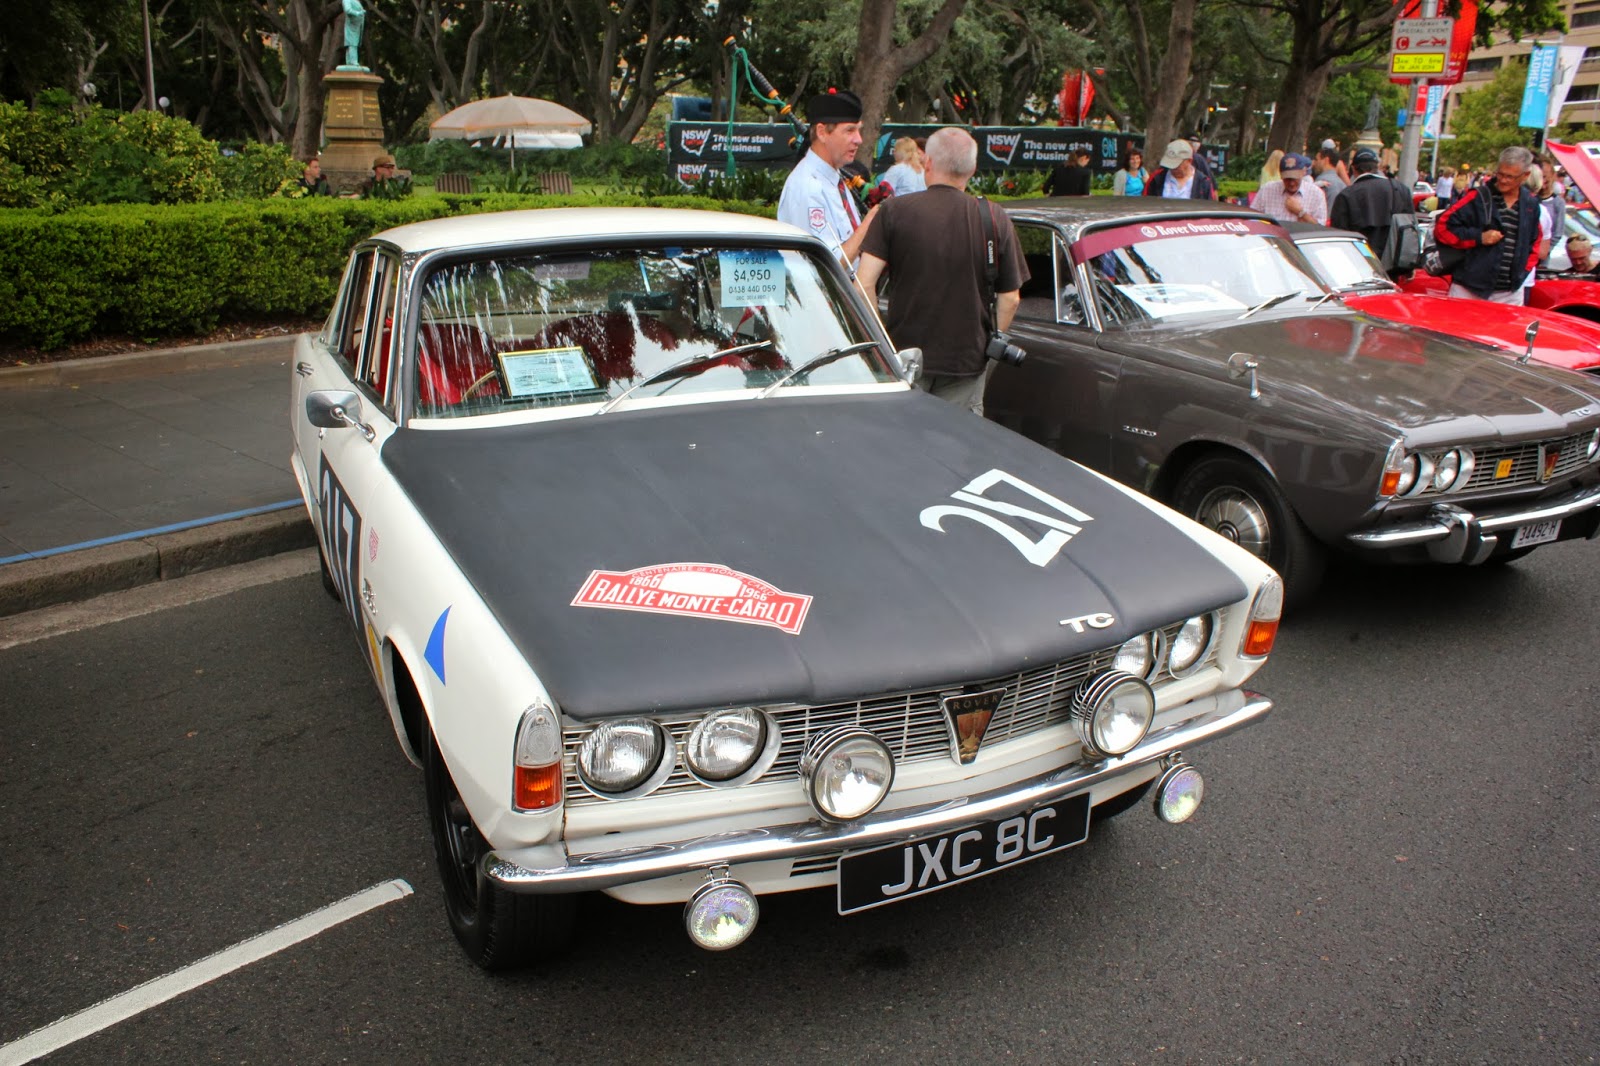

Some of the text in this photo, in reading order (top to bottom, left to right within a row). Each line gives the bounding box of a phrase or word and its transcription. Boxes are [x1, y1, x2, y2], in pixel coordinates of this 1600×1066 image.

[682, 130, 707, 140] NSW
[713, 135, 728, 143] The
[751, 135, 774, 144] state
[987, 134, 1015, 146] NSW
[711, 143, 722, 151] of
[1023, 140, 1044, 150] The
[1045, 142, 1067, 150] new
[1022, 151, 1071, 161] of busine
[677, 164, 702, 174] NSW
[1155, 225, 1189, 236] Rover
[1225, 221, 1250, 232] Club
[735, 257, 768, 265] FOR SALE
[733, 269, 771, 282] $4,950
[747, 285, 760, 293] 440
[762, 284, 777, 292] 059
[919, 468, 1095, 568] 217
[631, 566, 694, 578] CENTENAIRE
[629, 573, 663, 589] 1866
[739, 584, 768, 601] 1966
[588, 578, 795, 625] RALLYE MONTE-CARLO
[1059, 612, 1115, 633] TC
[953, 695, 998, 710] ROVER
[881, 807, 1057, 896] JXC 8C
